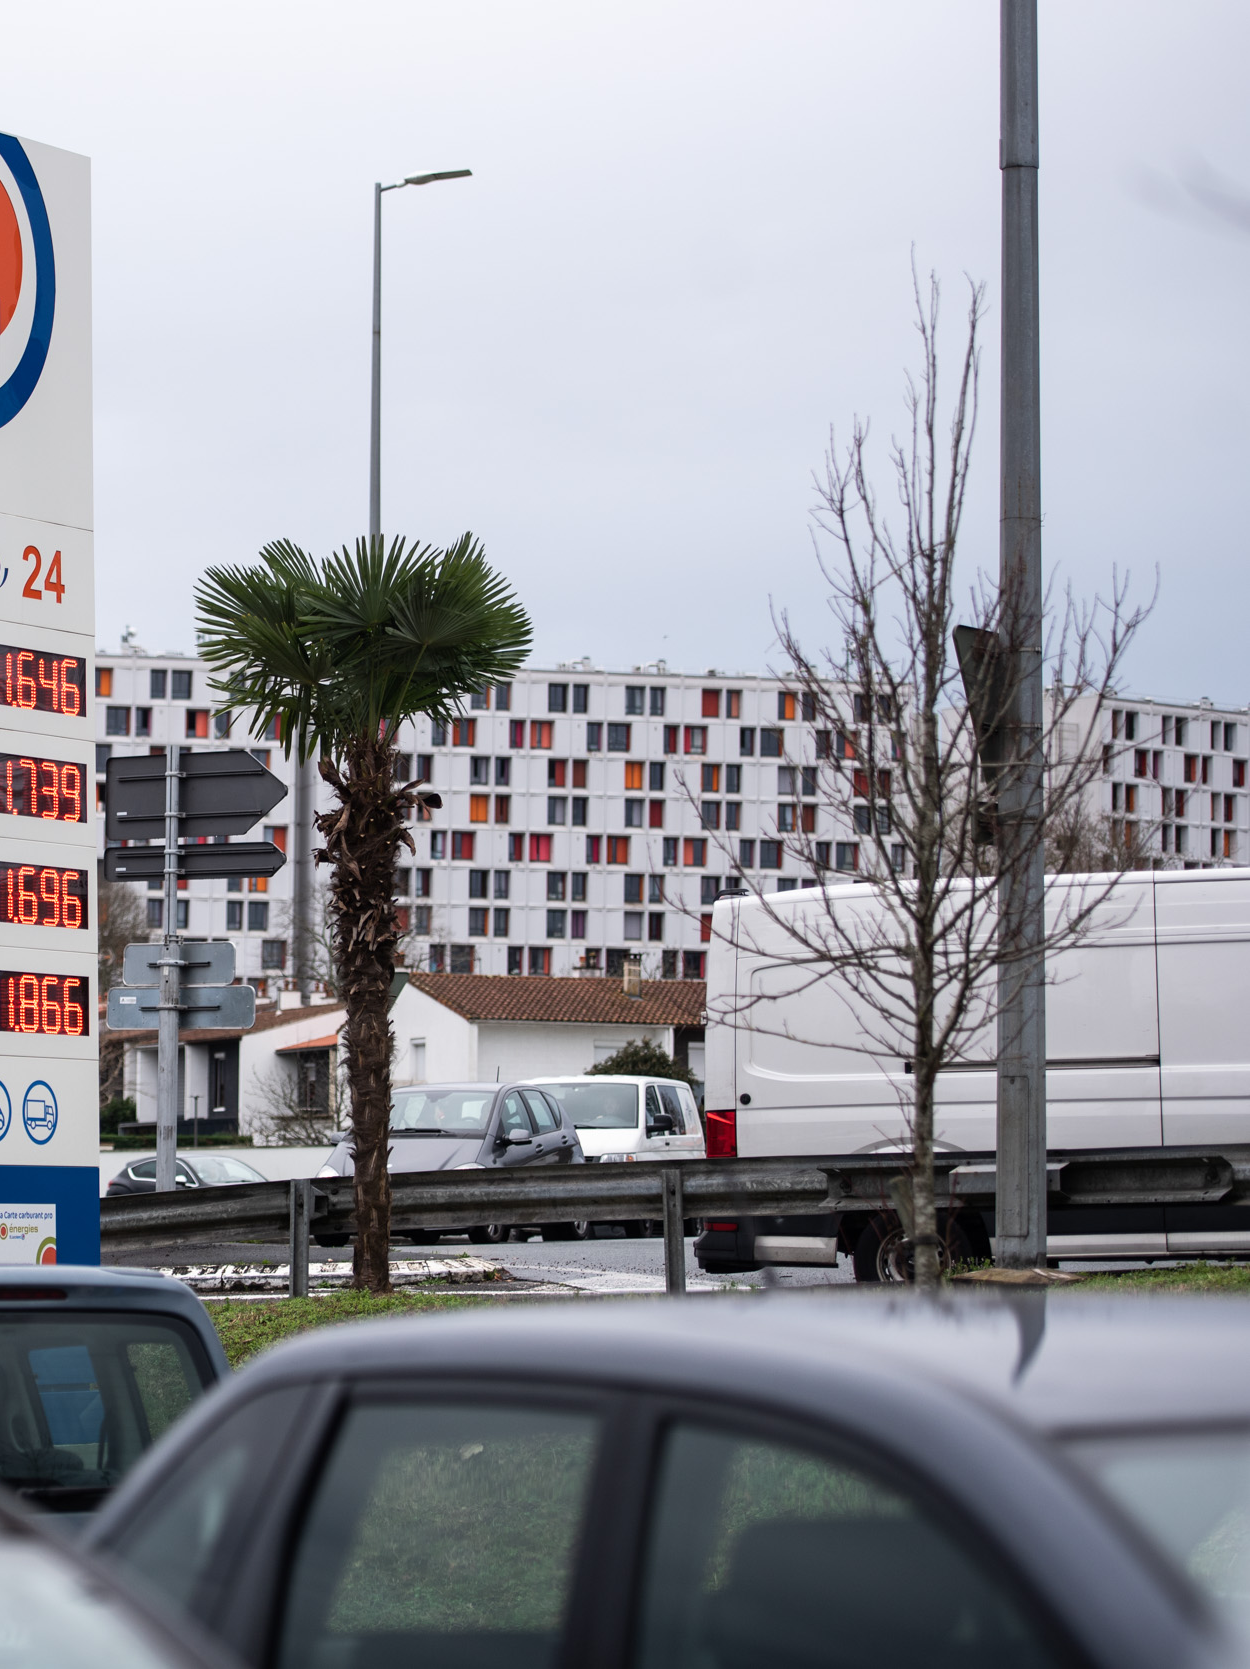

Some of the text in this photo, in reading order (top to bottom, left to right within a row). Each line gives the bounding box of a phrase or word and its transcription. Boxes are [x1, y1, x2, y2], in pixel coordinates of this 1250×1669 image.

[22, 545, 65, 604] 24
[4, 1211, 18, 1219] Carte
[18, 1211, 44, 1220] carburant
[44, 1212, 53, 1220] pro
[9, 1223, 39, 1235] énergies
